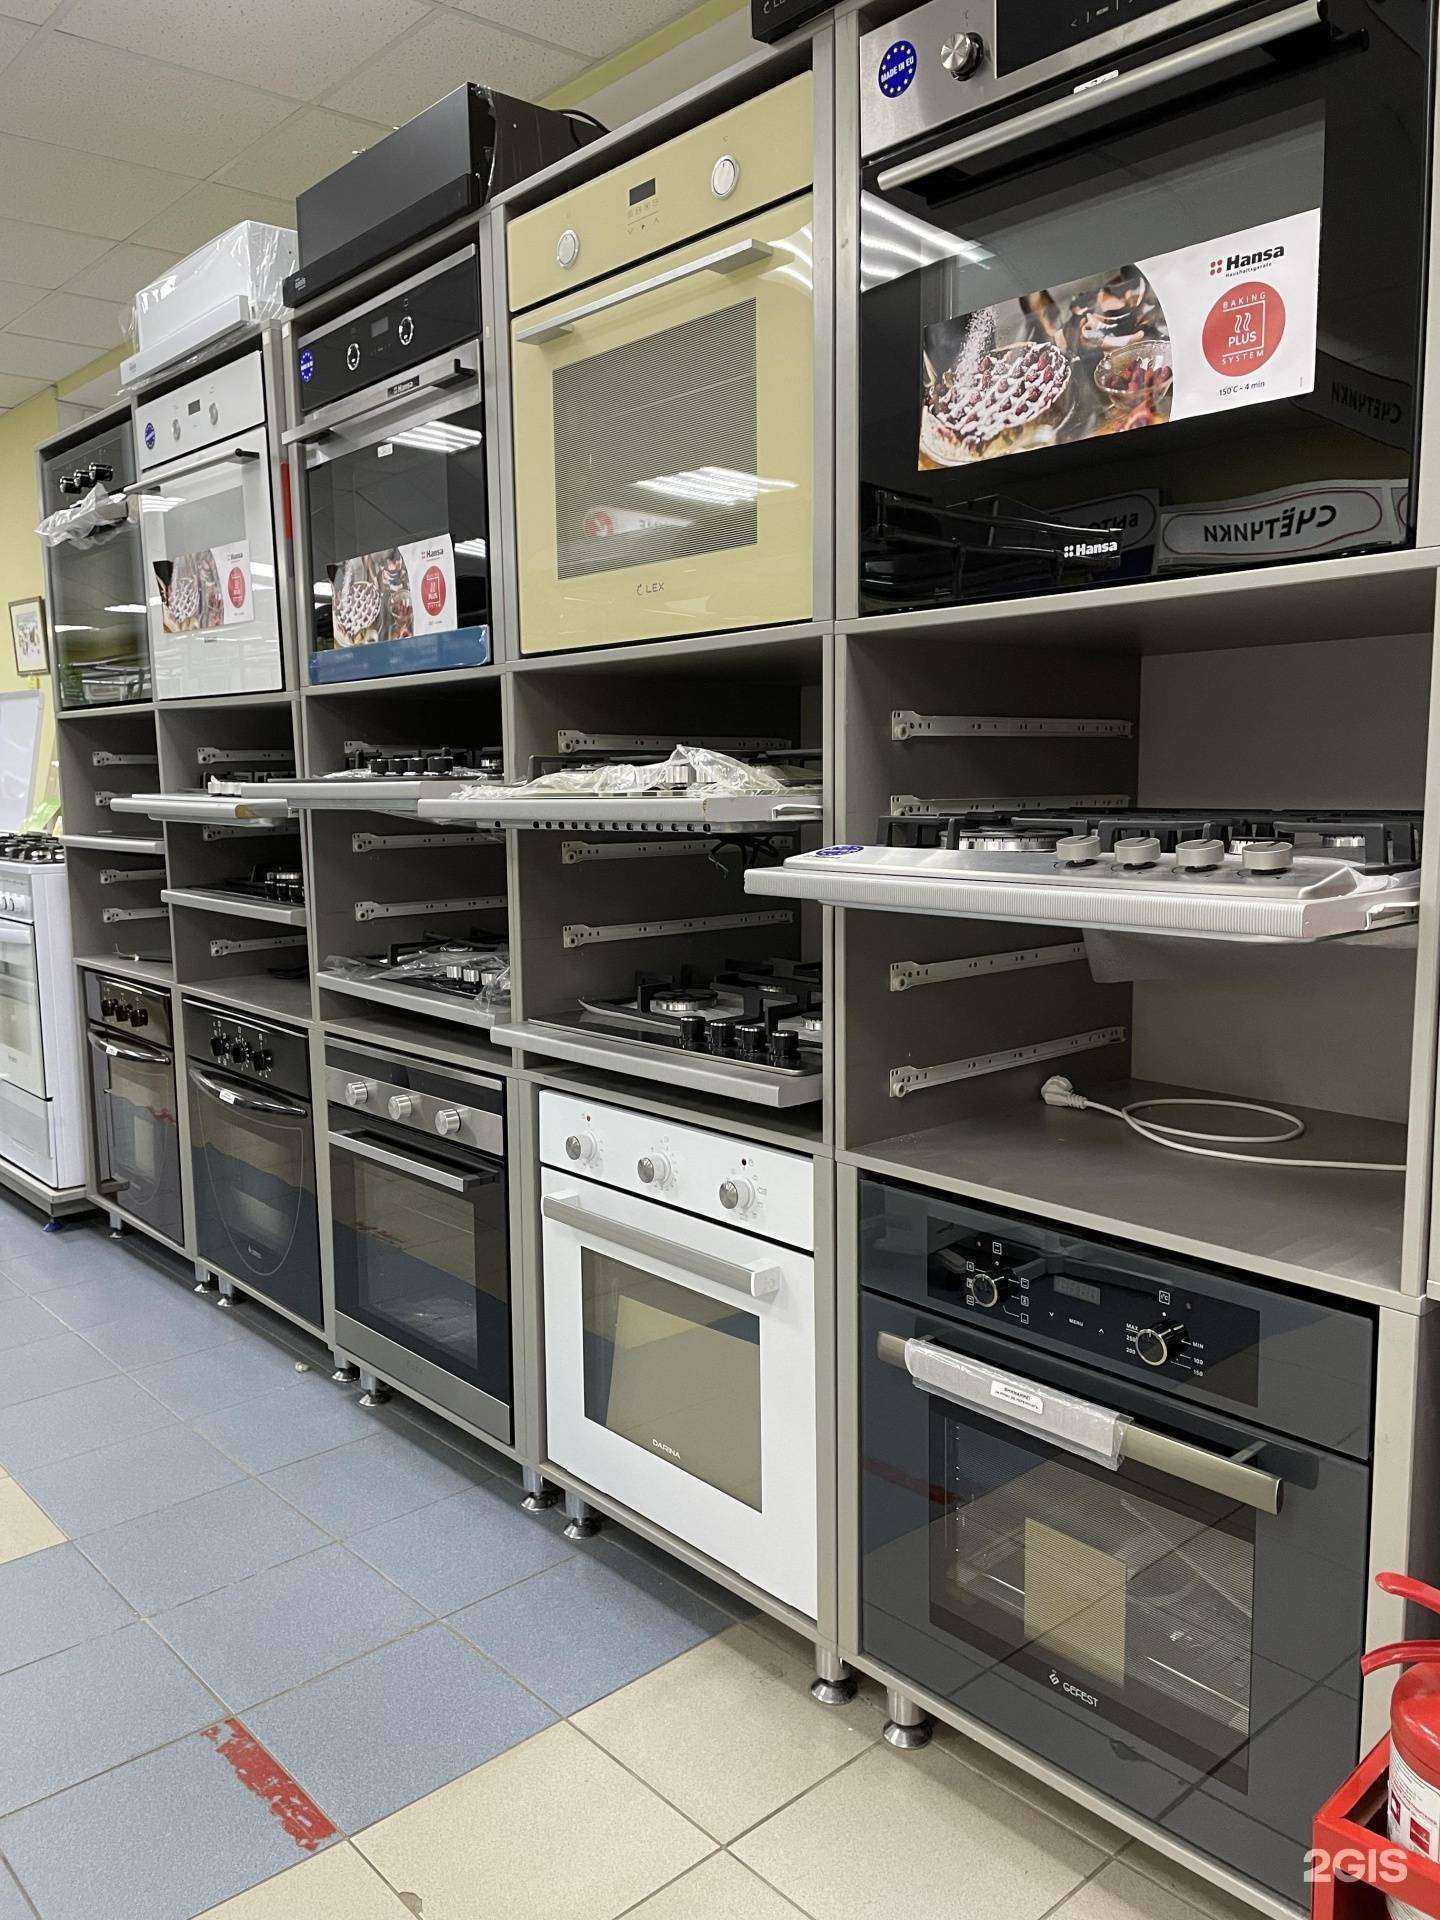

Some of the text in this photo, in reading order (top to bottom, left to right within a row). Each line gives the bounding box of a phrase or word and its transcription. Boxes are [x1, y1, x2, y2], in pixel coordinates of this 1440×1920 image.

[881, 56, 914, 83] MADE IN EU
[1226, 245, 1285, 271] Hansa
[1223, 291, 1266, 309] BAKING
[1228, 331, 1257, 347] PLUS
[1222, 350, 1264, 365] SYSTEM
[1250, 380, 1265, 389] min
[426, 548, 444, 558] Hansa
[1075, 541, 1118, 556] Hansa
[1068, 1317, 1084, 1327] MENU
[1126, 1322, 1139, 1332] MAX
[1192, 1340, 1204, 1350] MIN
[1063, 1682, 1099, 1707] GEFEST
